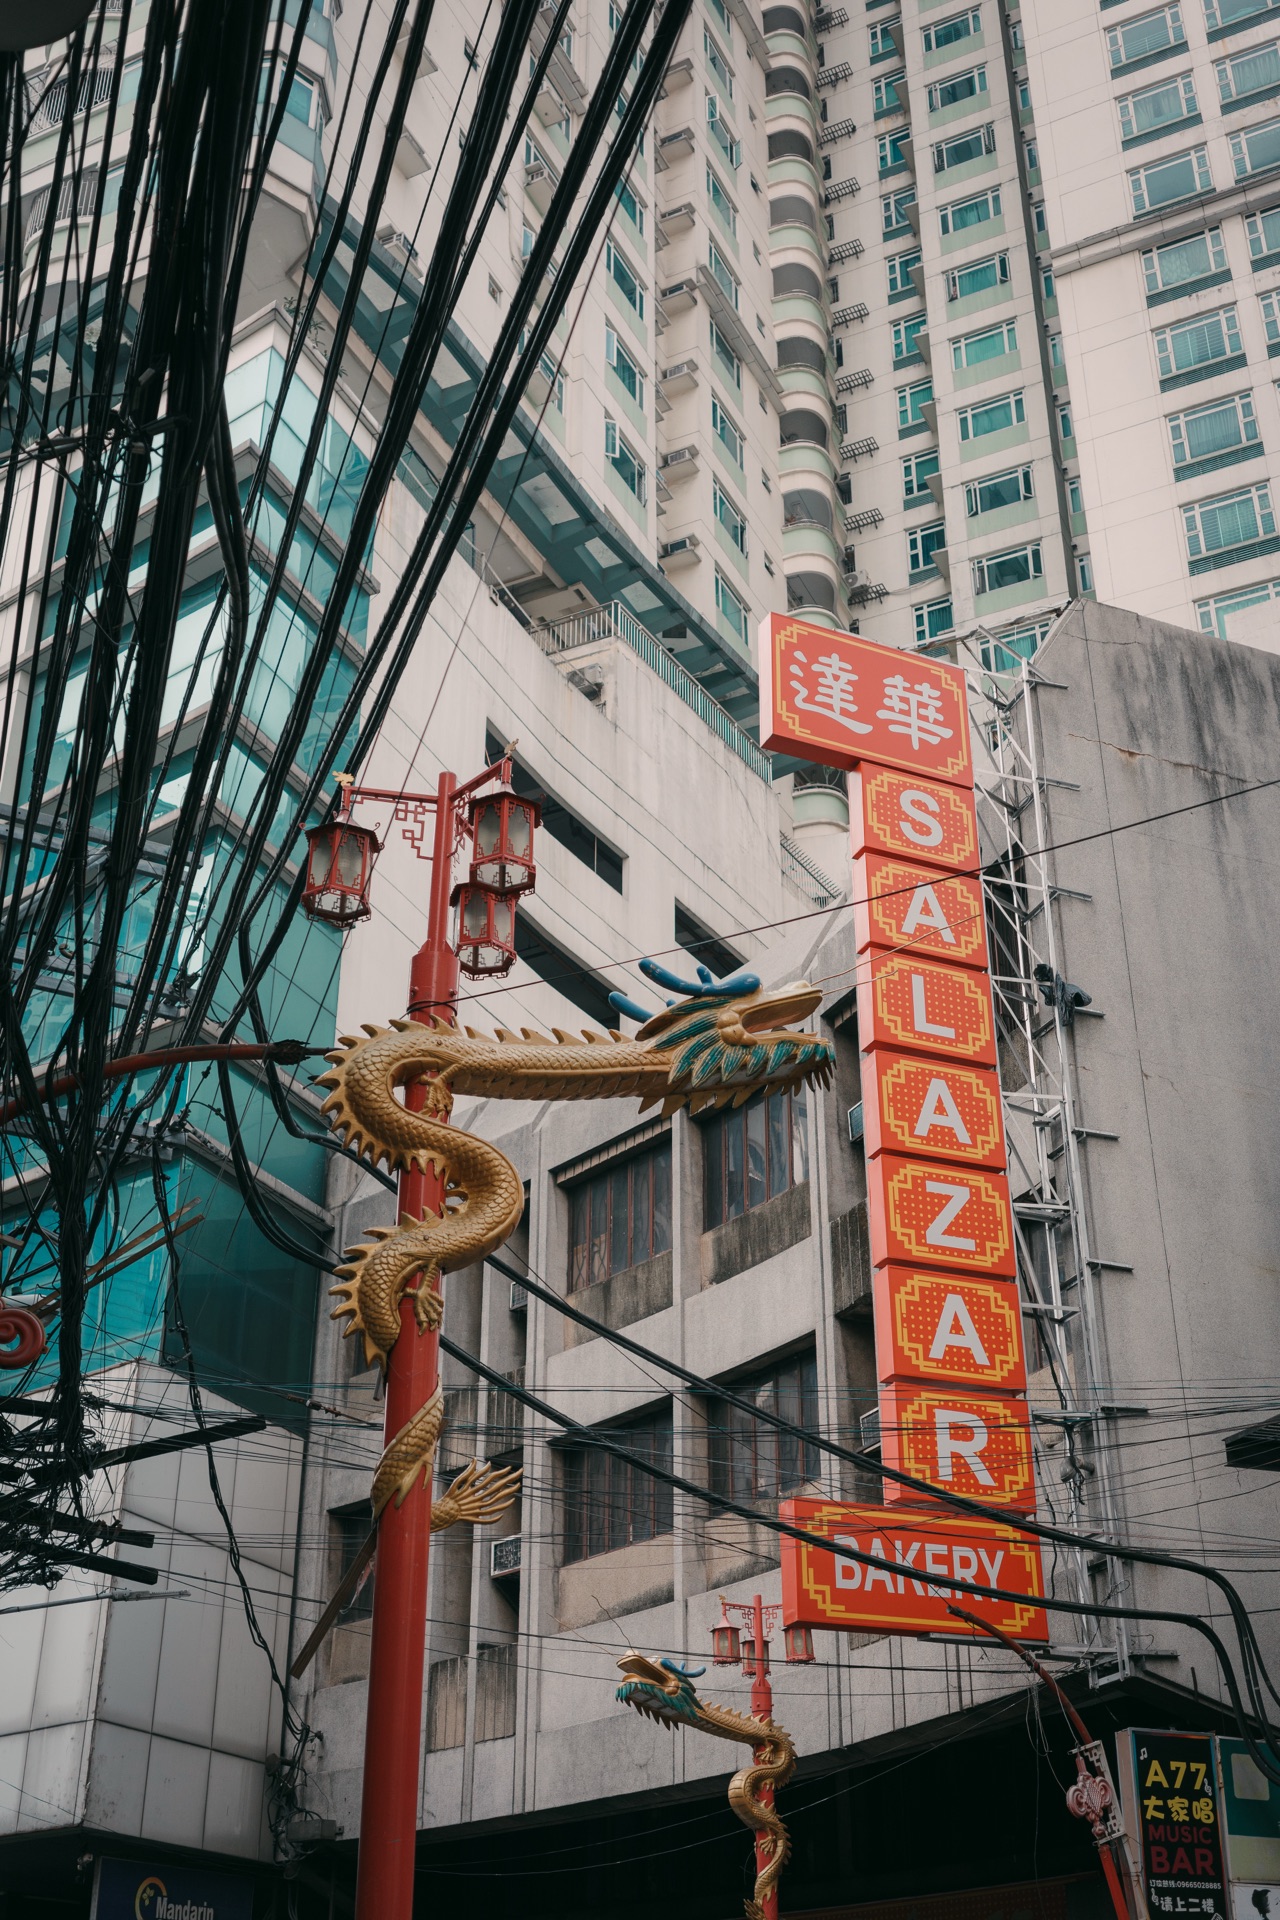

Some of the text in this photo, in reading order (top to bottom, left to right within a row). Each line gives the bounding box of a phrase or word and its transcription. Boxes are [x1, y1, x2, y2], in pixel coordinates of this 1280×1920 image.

[899, 789, 997, 1486] SALAZAR
[833, 1534, 1004, 1603] BAKERY
[1145, 1760, 1207, 1790] A77
[1143, 1795, 1215, 1824] 大家唱
[1148, 1824, 1213, 1844] MUSIC
[1151, 1846, 1216, 1876] BAR
[155, 1896, 214, 1920] Mandarin
[1160, 1896, 1215, 1914] 请上二楼
